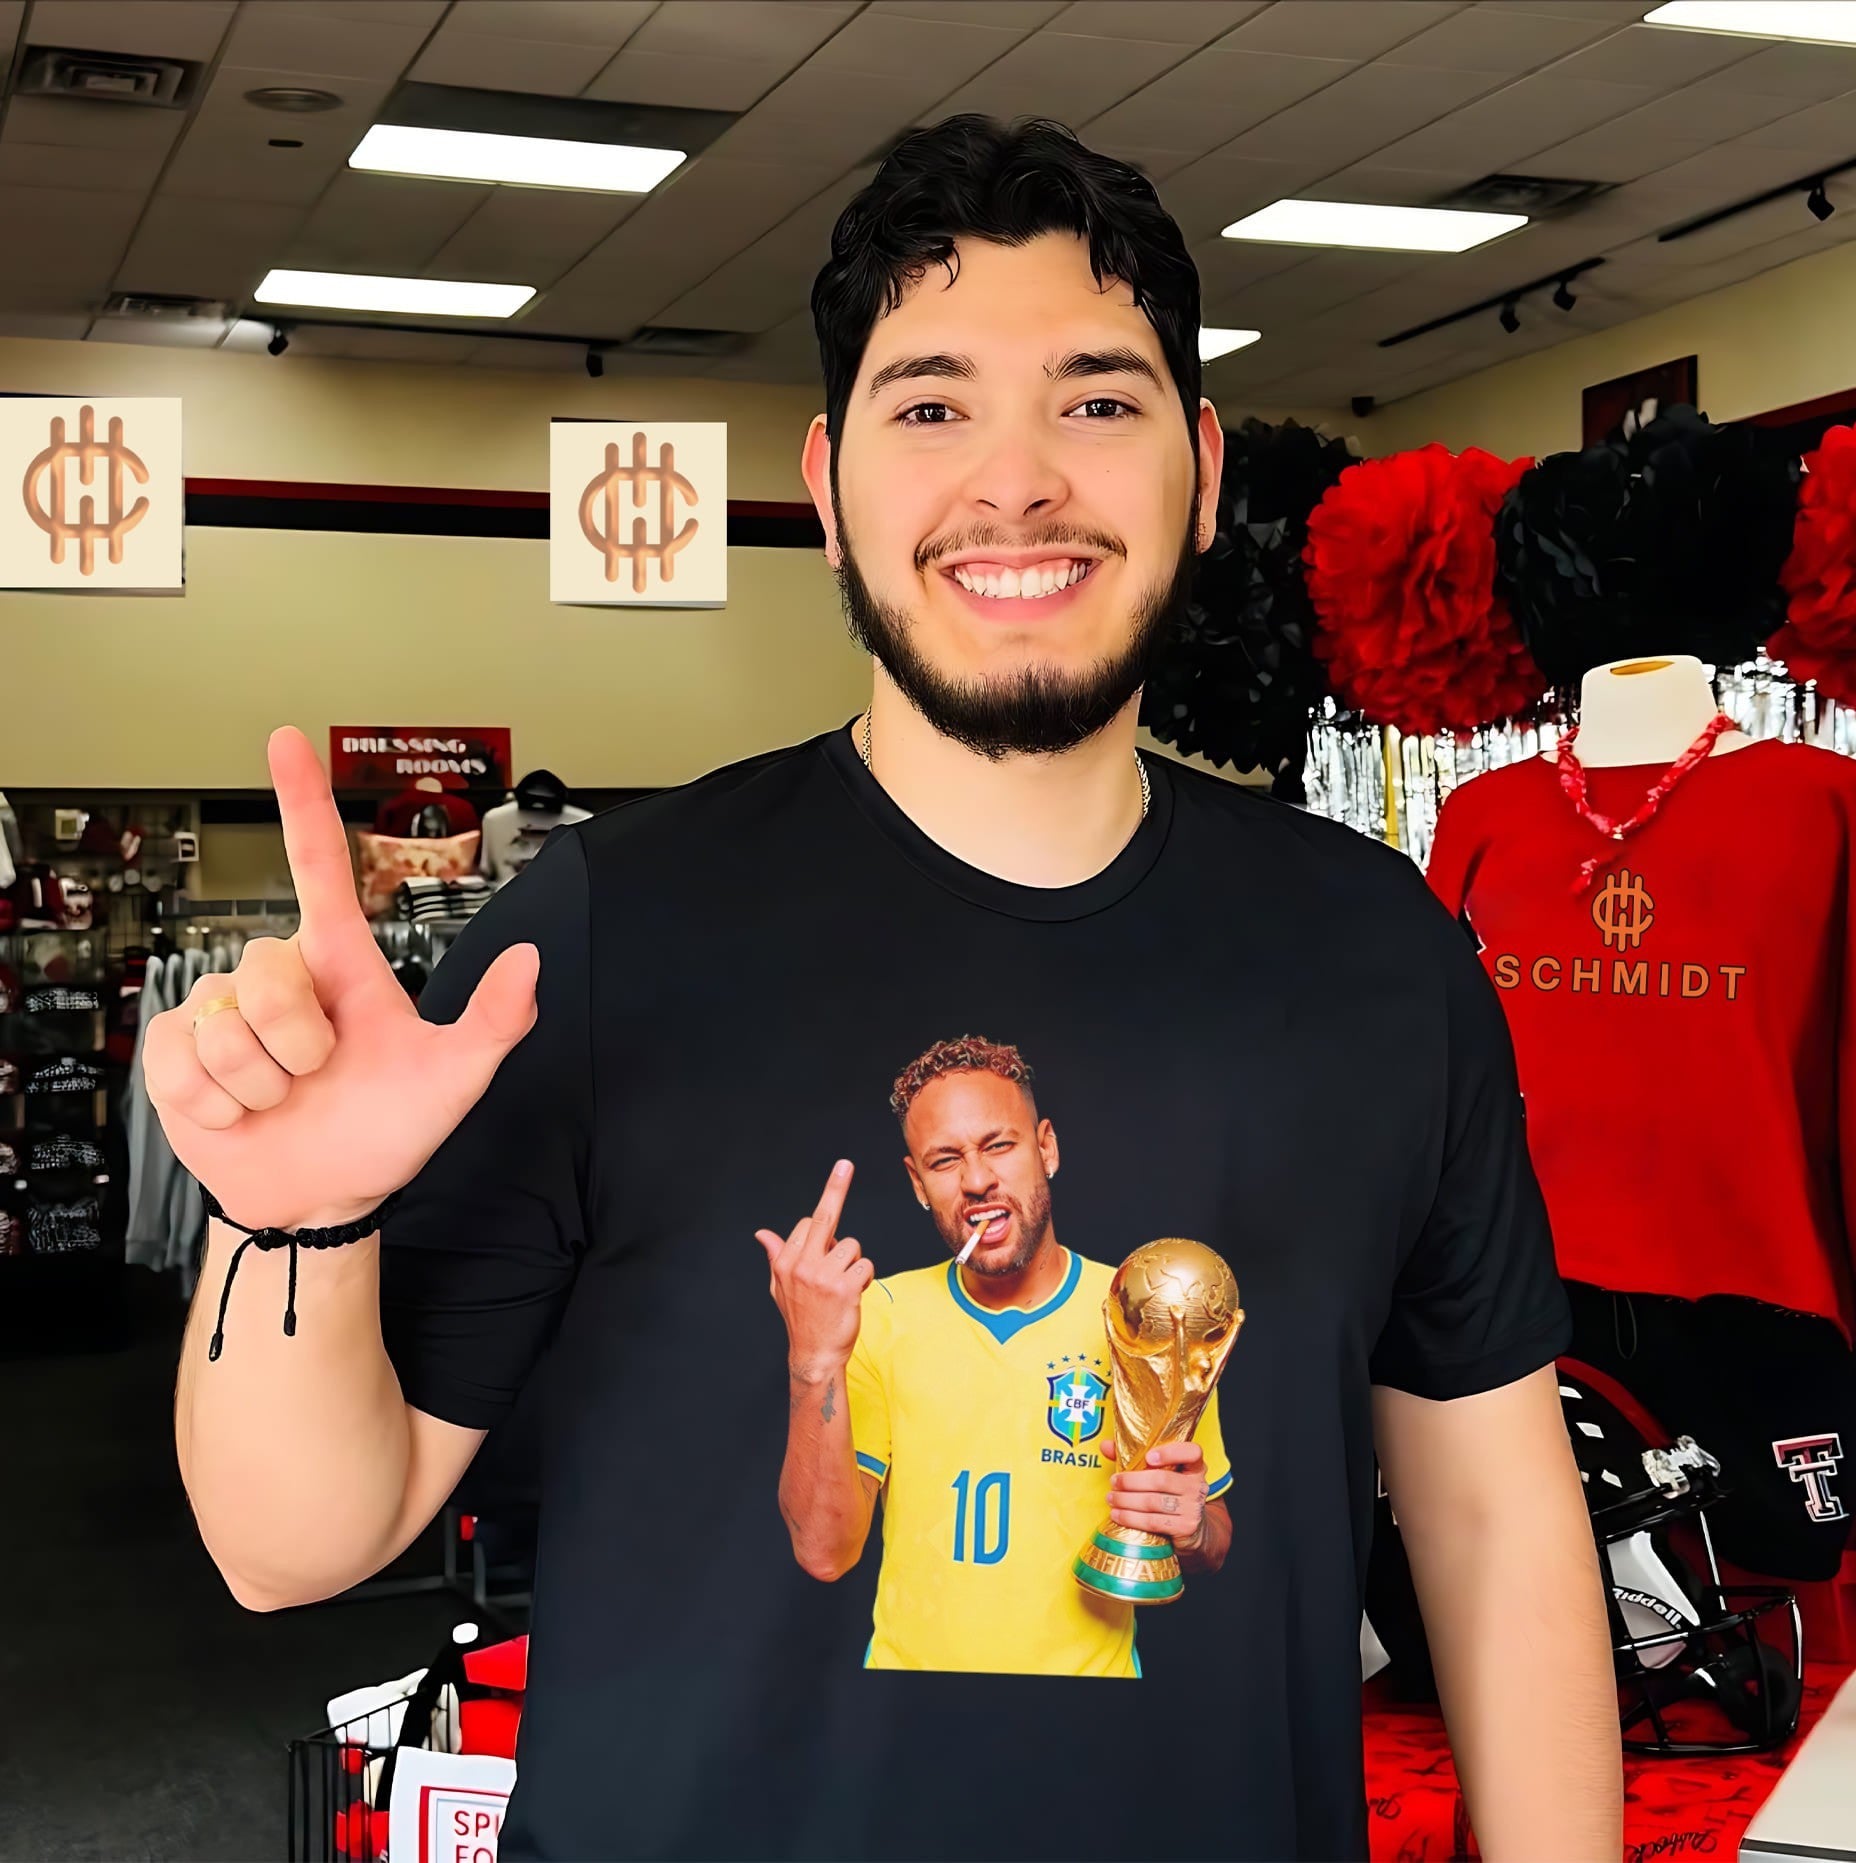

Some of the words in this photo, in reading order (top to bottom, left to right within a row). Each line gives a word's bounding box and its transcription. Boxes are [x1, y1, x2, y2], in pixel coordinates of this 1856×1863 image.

[396, 758, 487, 775] ROOMS
[1493, 954, 1748, 1000] SCHMIDT
[1065, 1398, 1090, 1409] CBF
[1041, 1448, 1102, 1468] BRASIL
[951, 1469, 1012, 1565] 10
